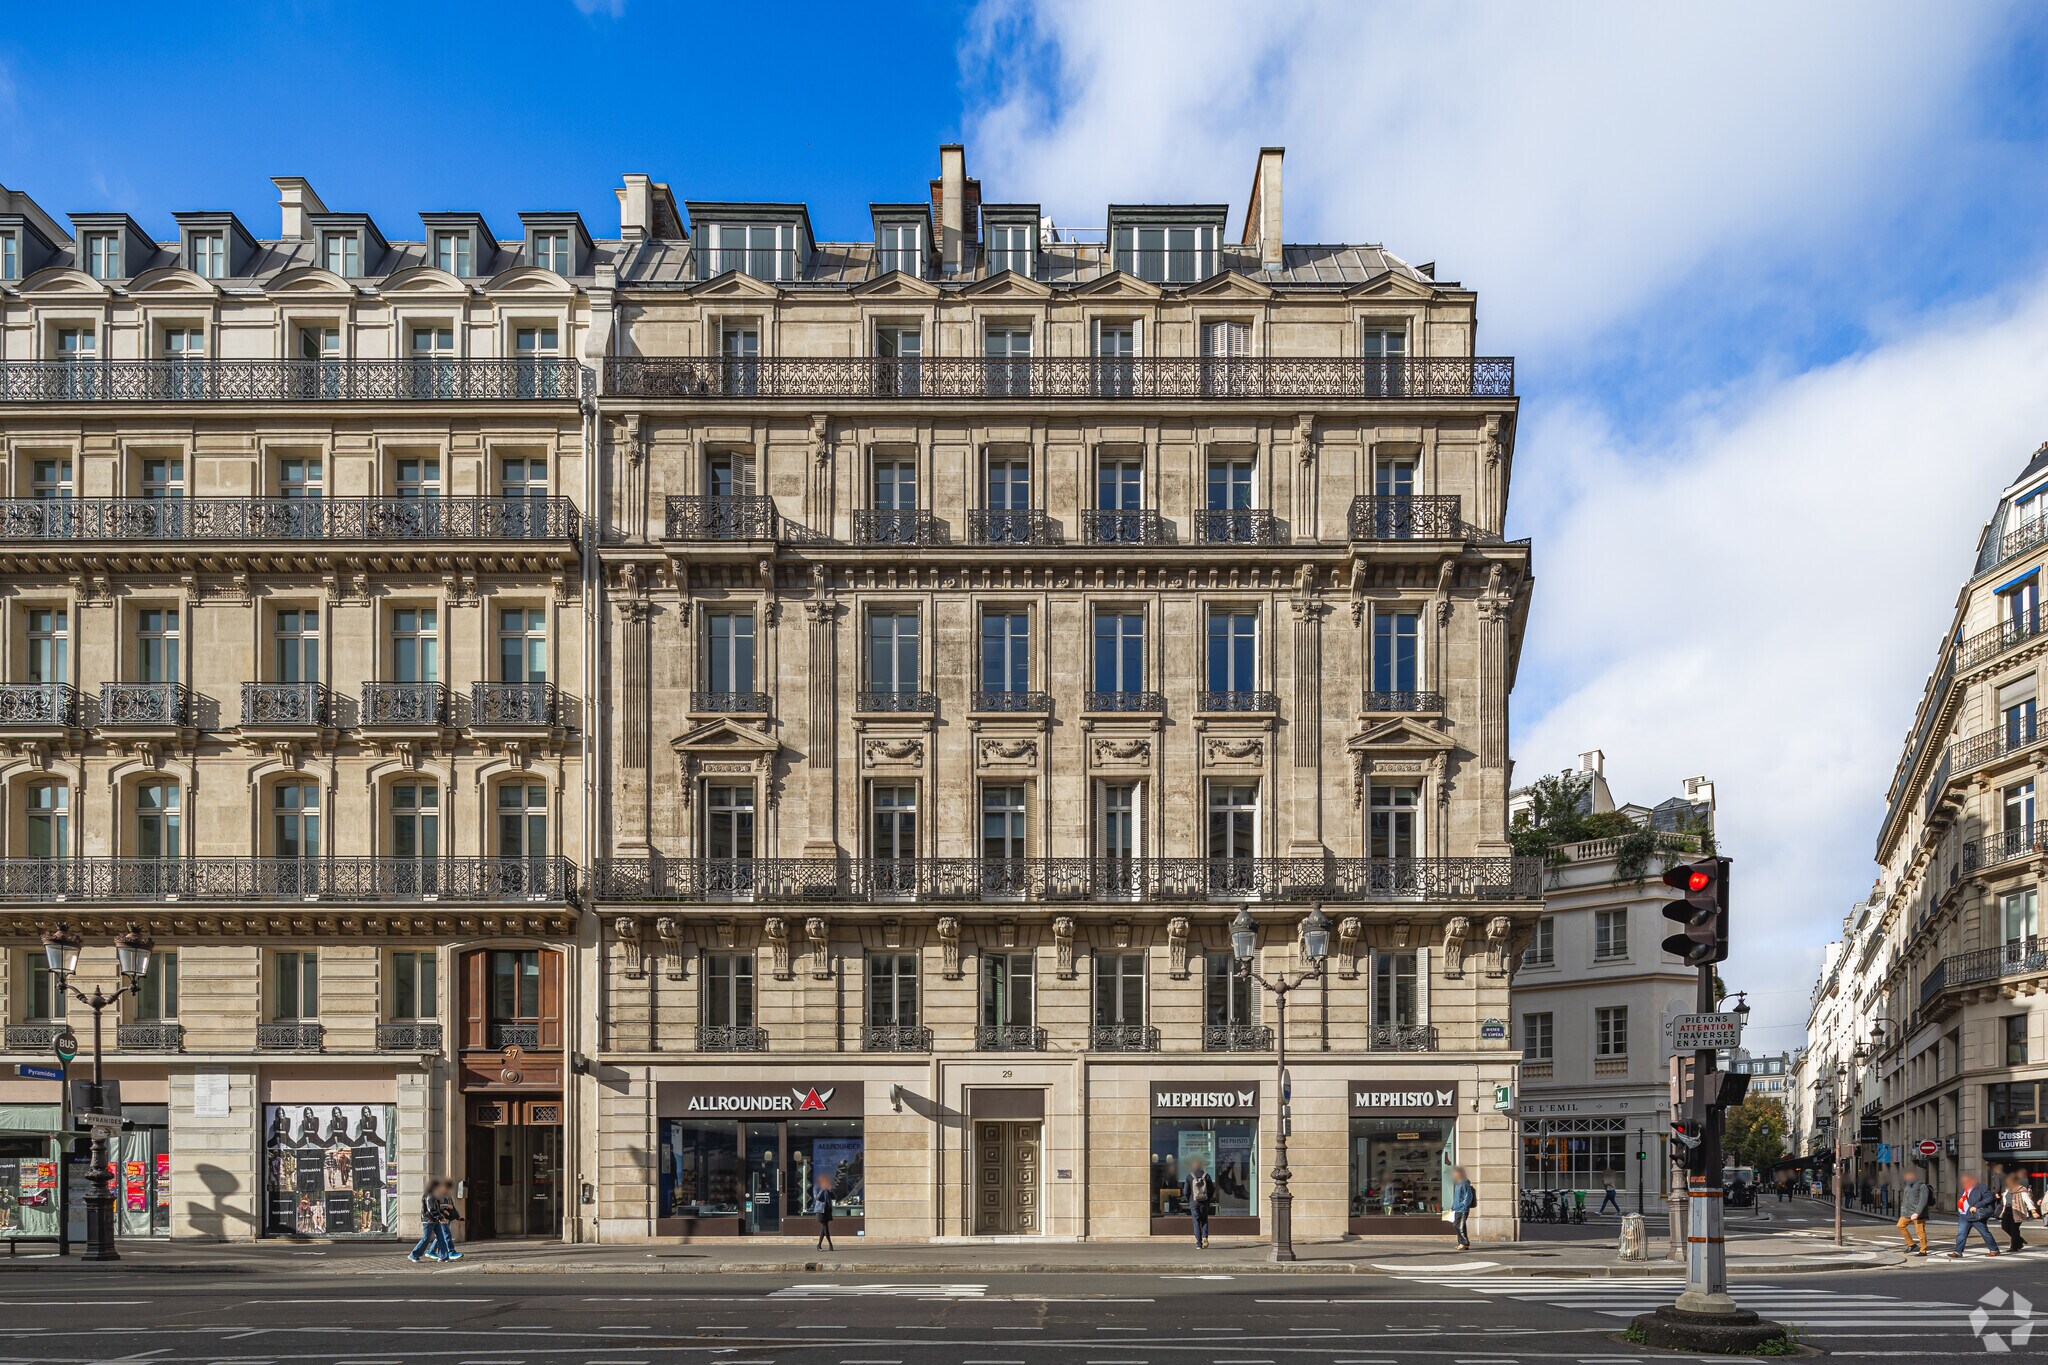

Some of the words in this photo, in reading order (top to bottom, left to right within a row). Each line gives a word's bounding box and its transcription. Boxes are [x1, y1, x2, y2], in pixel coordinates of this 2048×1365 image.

[1678, 1031, 1736, 1039] TRAVERSEZ
[60, 1038, 75, 1048] BUS
[506, 1049, 518, 1059] 27
[28, 1068, 56, 1078] Pyramides
[1002, 1070, 1013, 1078] 29
[688, 1096, 793, 1111] ALLROUNDER
[1157, 1092, 1235, 1108] MEPHISTO
[1355, 1092, 1434, 1108] MEPHISTO
[1540, 1104, 1578, 1112] L'EMIL
[1998, 1130, 2032, 1140] CrossFit
[2000, 1140, 2030, 1149] LOUVRE
